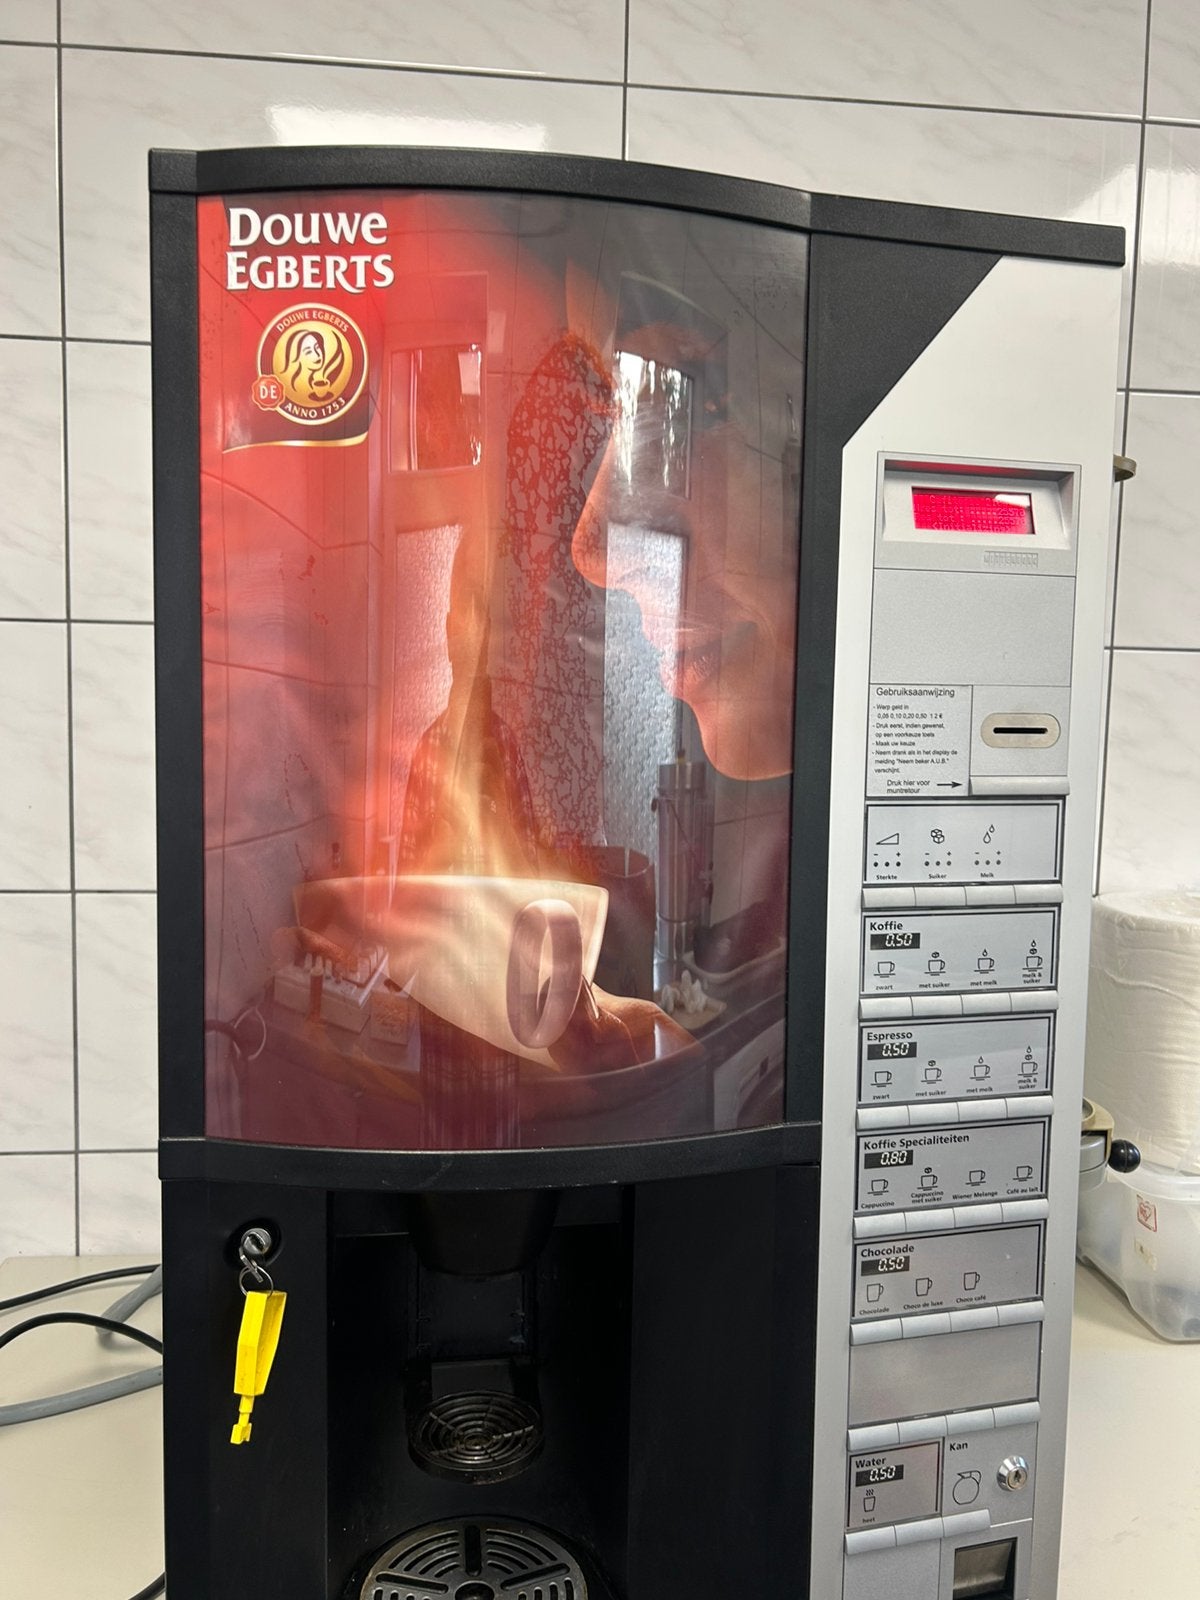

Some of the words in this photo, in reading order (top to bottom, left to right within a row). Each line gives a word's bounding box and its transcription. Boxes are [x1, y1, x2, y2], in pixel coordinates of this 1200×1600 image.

[229, 208, 387, 246] Douwe
[226, 251, 395, 293] EGBERTS
[276, 310, 310, 333] DOUWE
[312, 310, 349, 333] EGBERTS
[284, 402, 318, 419] ANNO
[321, 397, 346, 417] 1753
[876, 687, 955, 698] Gebruiksaanwijzing
[869, 921, 903, 931] Koffie
[867, 1031, 913, 1042] Espresso
[864, 1139, 897, 1151] Koffie
[899, 1134, 970, 1149] Specialiteiten
[910, 1190, 944, 1199] Cappuccino
[860, 1200, 895, 1210] Cappuccino
[861, 1244, 915, 1258] Chocolade
[859, 1307, 890, 1316] Chocolade
[949, 1442, 968, 1451] Kan
[855, 1457, 887, 1469] Water
